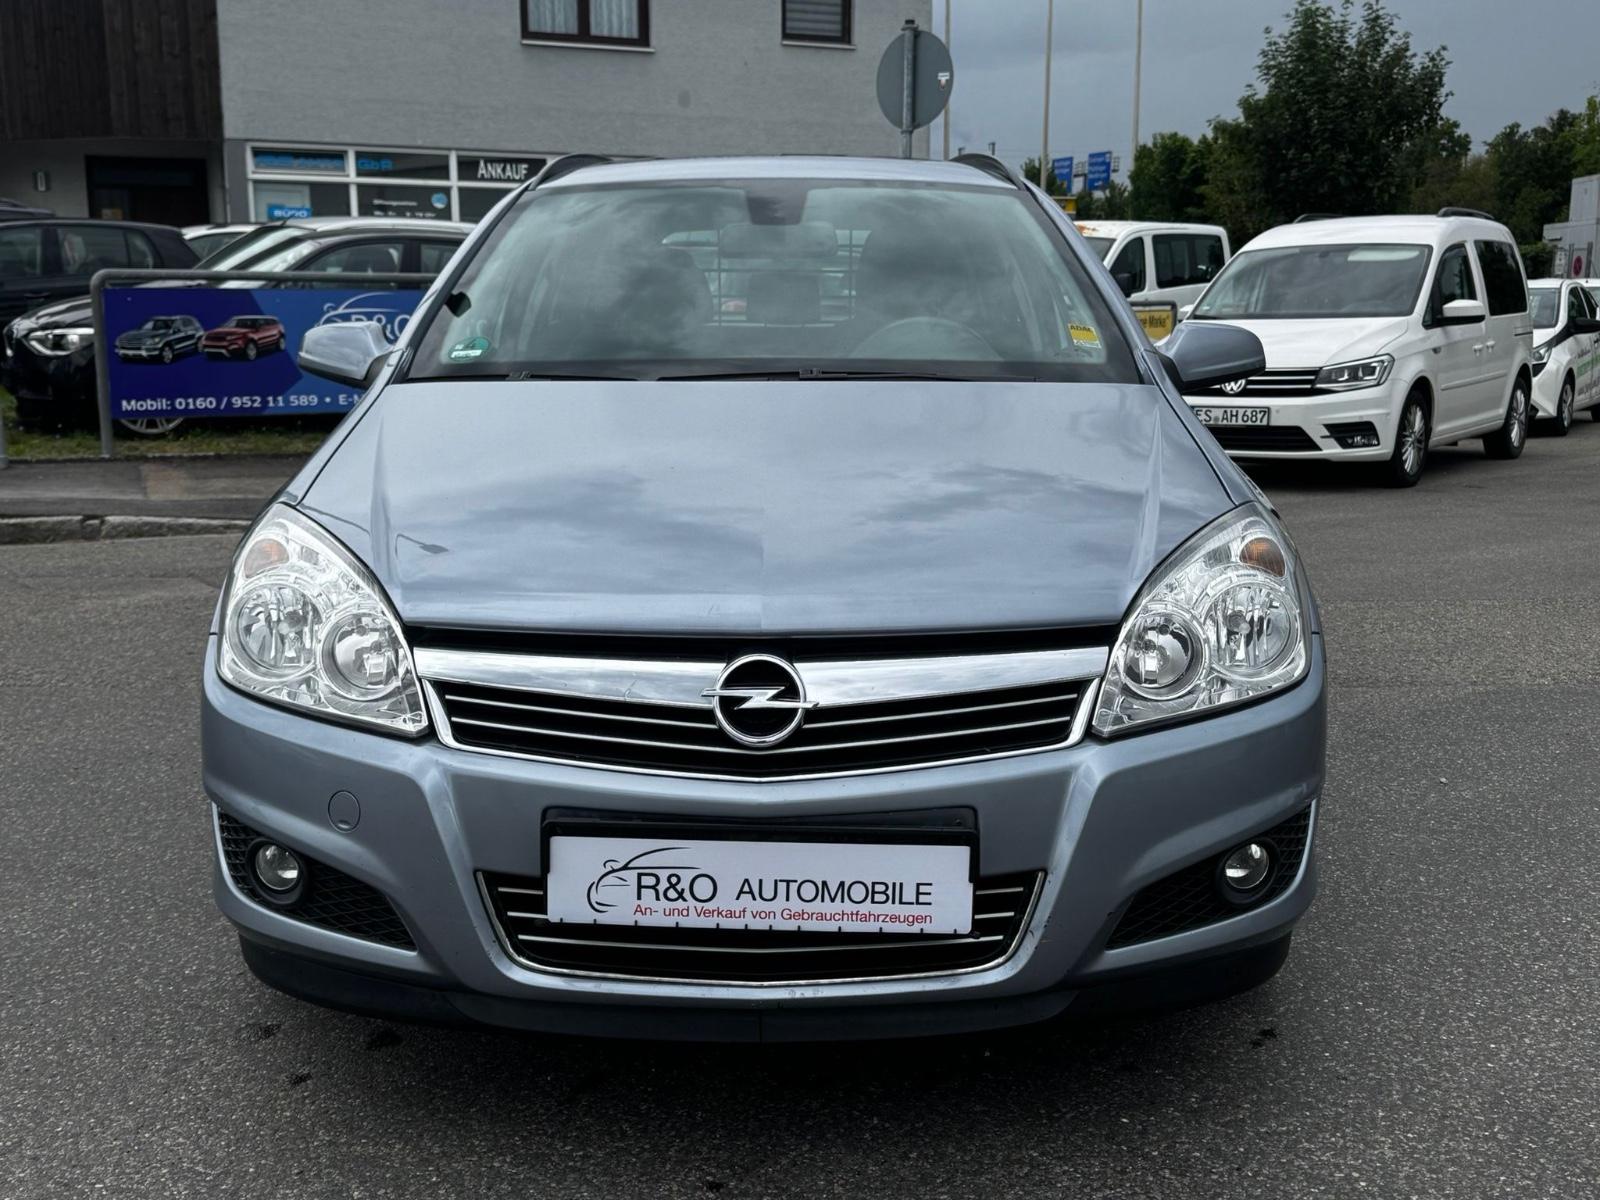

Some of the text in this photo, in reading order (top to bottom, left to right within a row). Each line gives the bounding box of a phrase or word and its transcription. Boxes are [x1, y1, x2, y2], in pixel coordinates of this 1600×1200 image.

[477, 159, 529, 180] ANKAUF
[121, 399, 172, 412] Mobil:
[175, 397, 217, 409] 0160
[231, 396, 262, 408] 952
[267, 396, 285, 407] 11
[289, 394, 319, 406] 589
[1195, 409, 1268, 424] ES AH 687
[636, 872, 933, 906] R&O AUTOMOBILE
[633, 903, 933, 927] An- und Verkauf von Gebrauchtfahrzeugen
